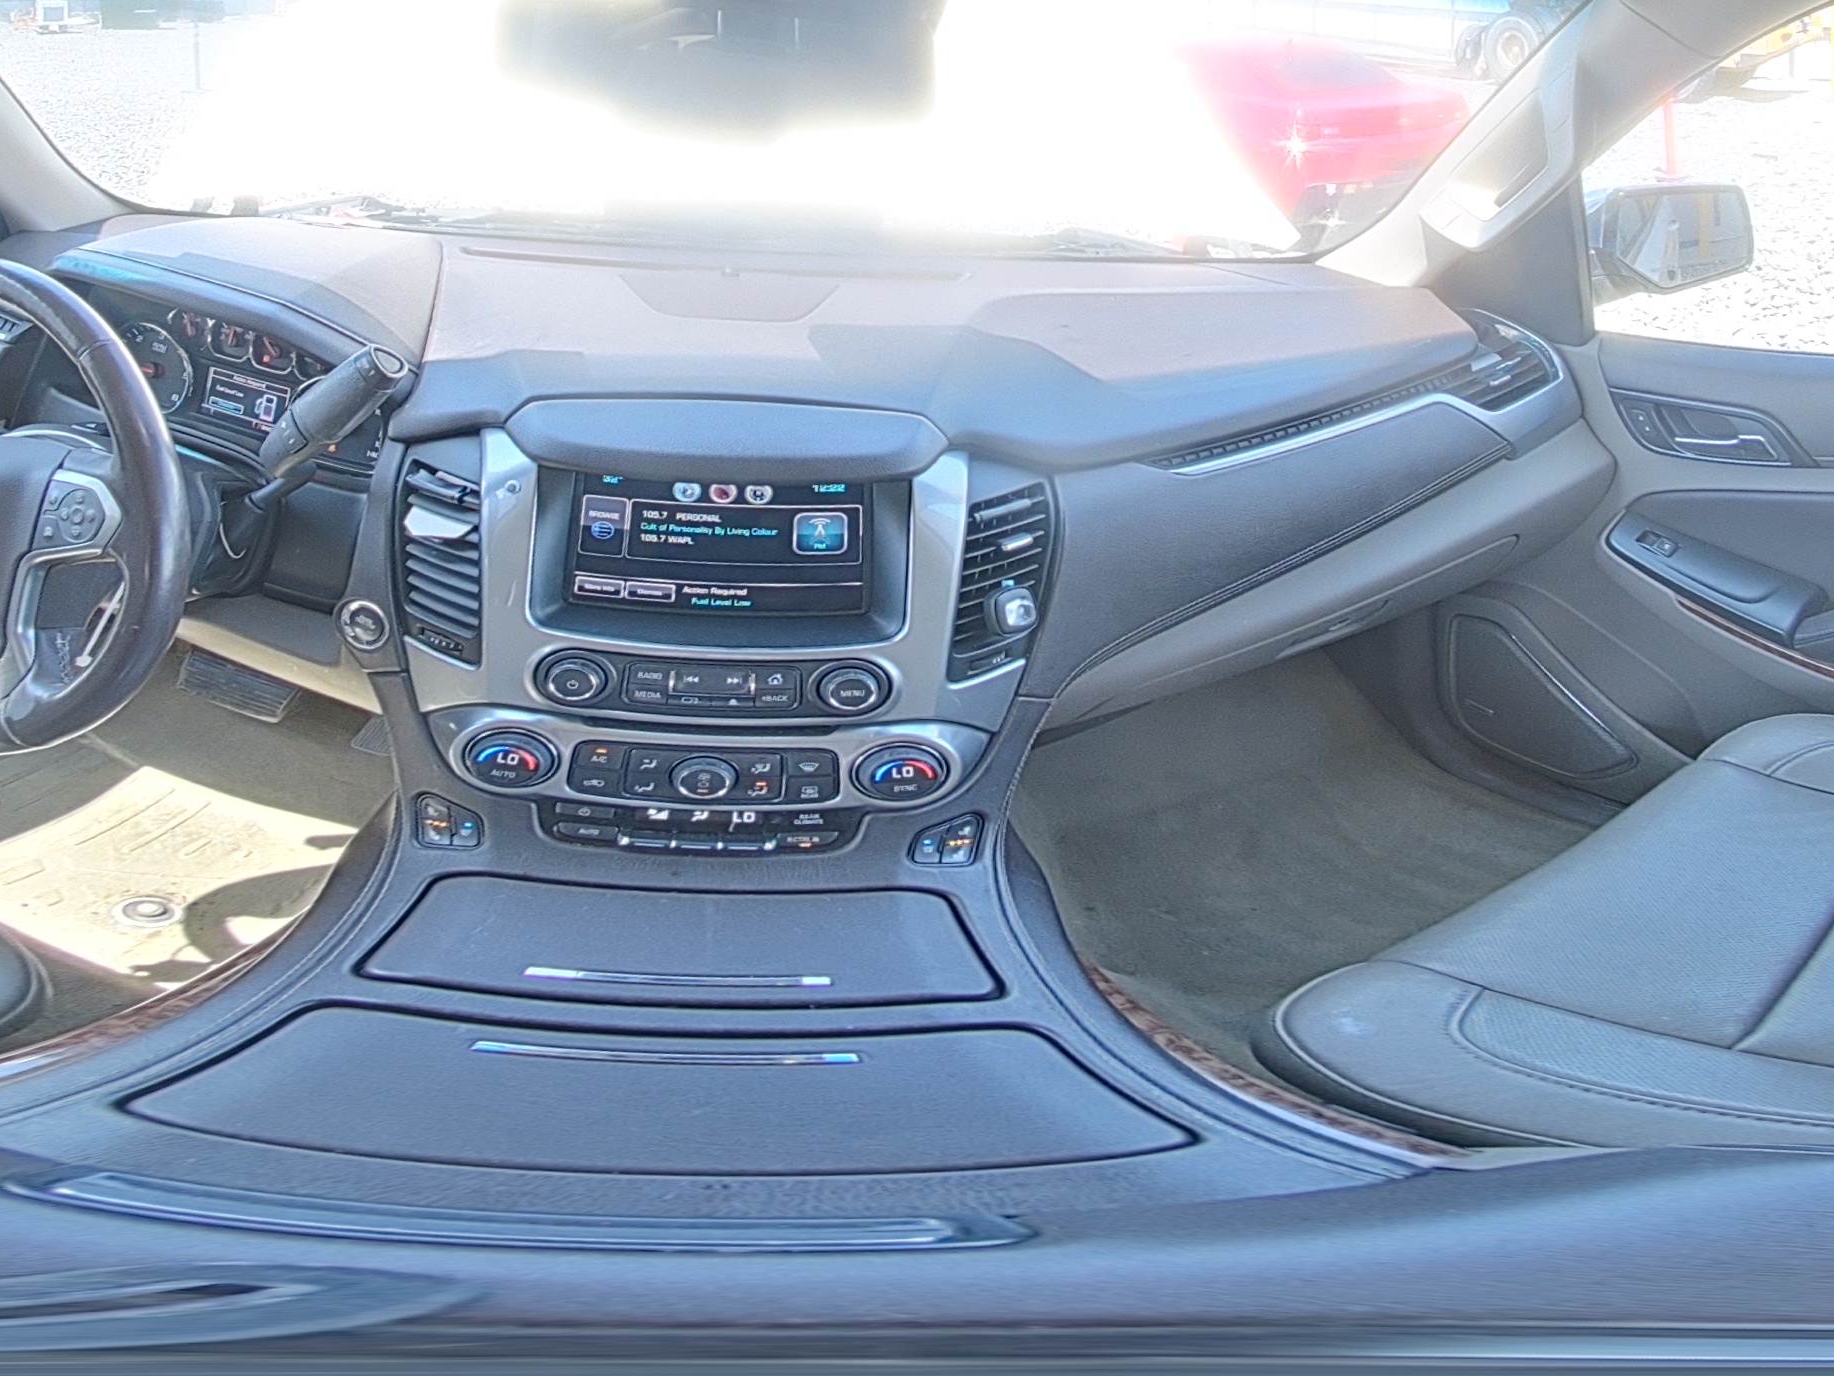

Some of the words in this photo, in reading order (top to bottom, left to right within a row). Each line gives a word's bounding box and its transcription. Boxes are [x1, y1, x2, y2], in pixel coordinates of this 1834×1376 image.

[641, 510, 669, 520] 105.7
[675, 512, 723, 523] PERSONAL
[639, 522, 658, 532] Cult
[658, 523, 668, 532] of
[714, 526, 725, 536] By
[726, 527, 751, 537] Living
[750, 527, 779, 537] Colour
[639, 533, 667, 543] 105.7
[681, 585, 709, 595] Action
[709, 586, 748, 597] Required
[691, 597, 709, 606] Fuel
[733, 598, 752, 607] Low
[637, 671, 663, 680] RADIO
[634, 689, 662, 699] MEDIA
[840, 689, 866, 698] MENU
[496, 752, 520, 766] LO
[589, 755, 608, 763] A/C
[489, 769, 516, 779] AUTO
[891, 766, 915, 779] LO
[893, 784, 918, 792] SYNC
[732, 811, 756, 824] LO
[578, 827, 601, 836] AUTO
